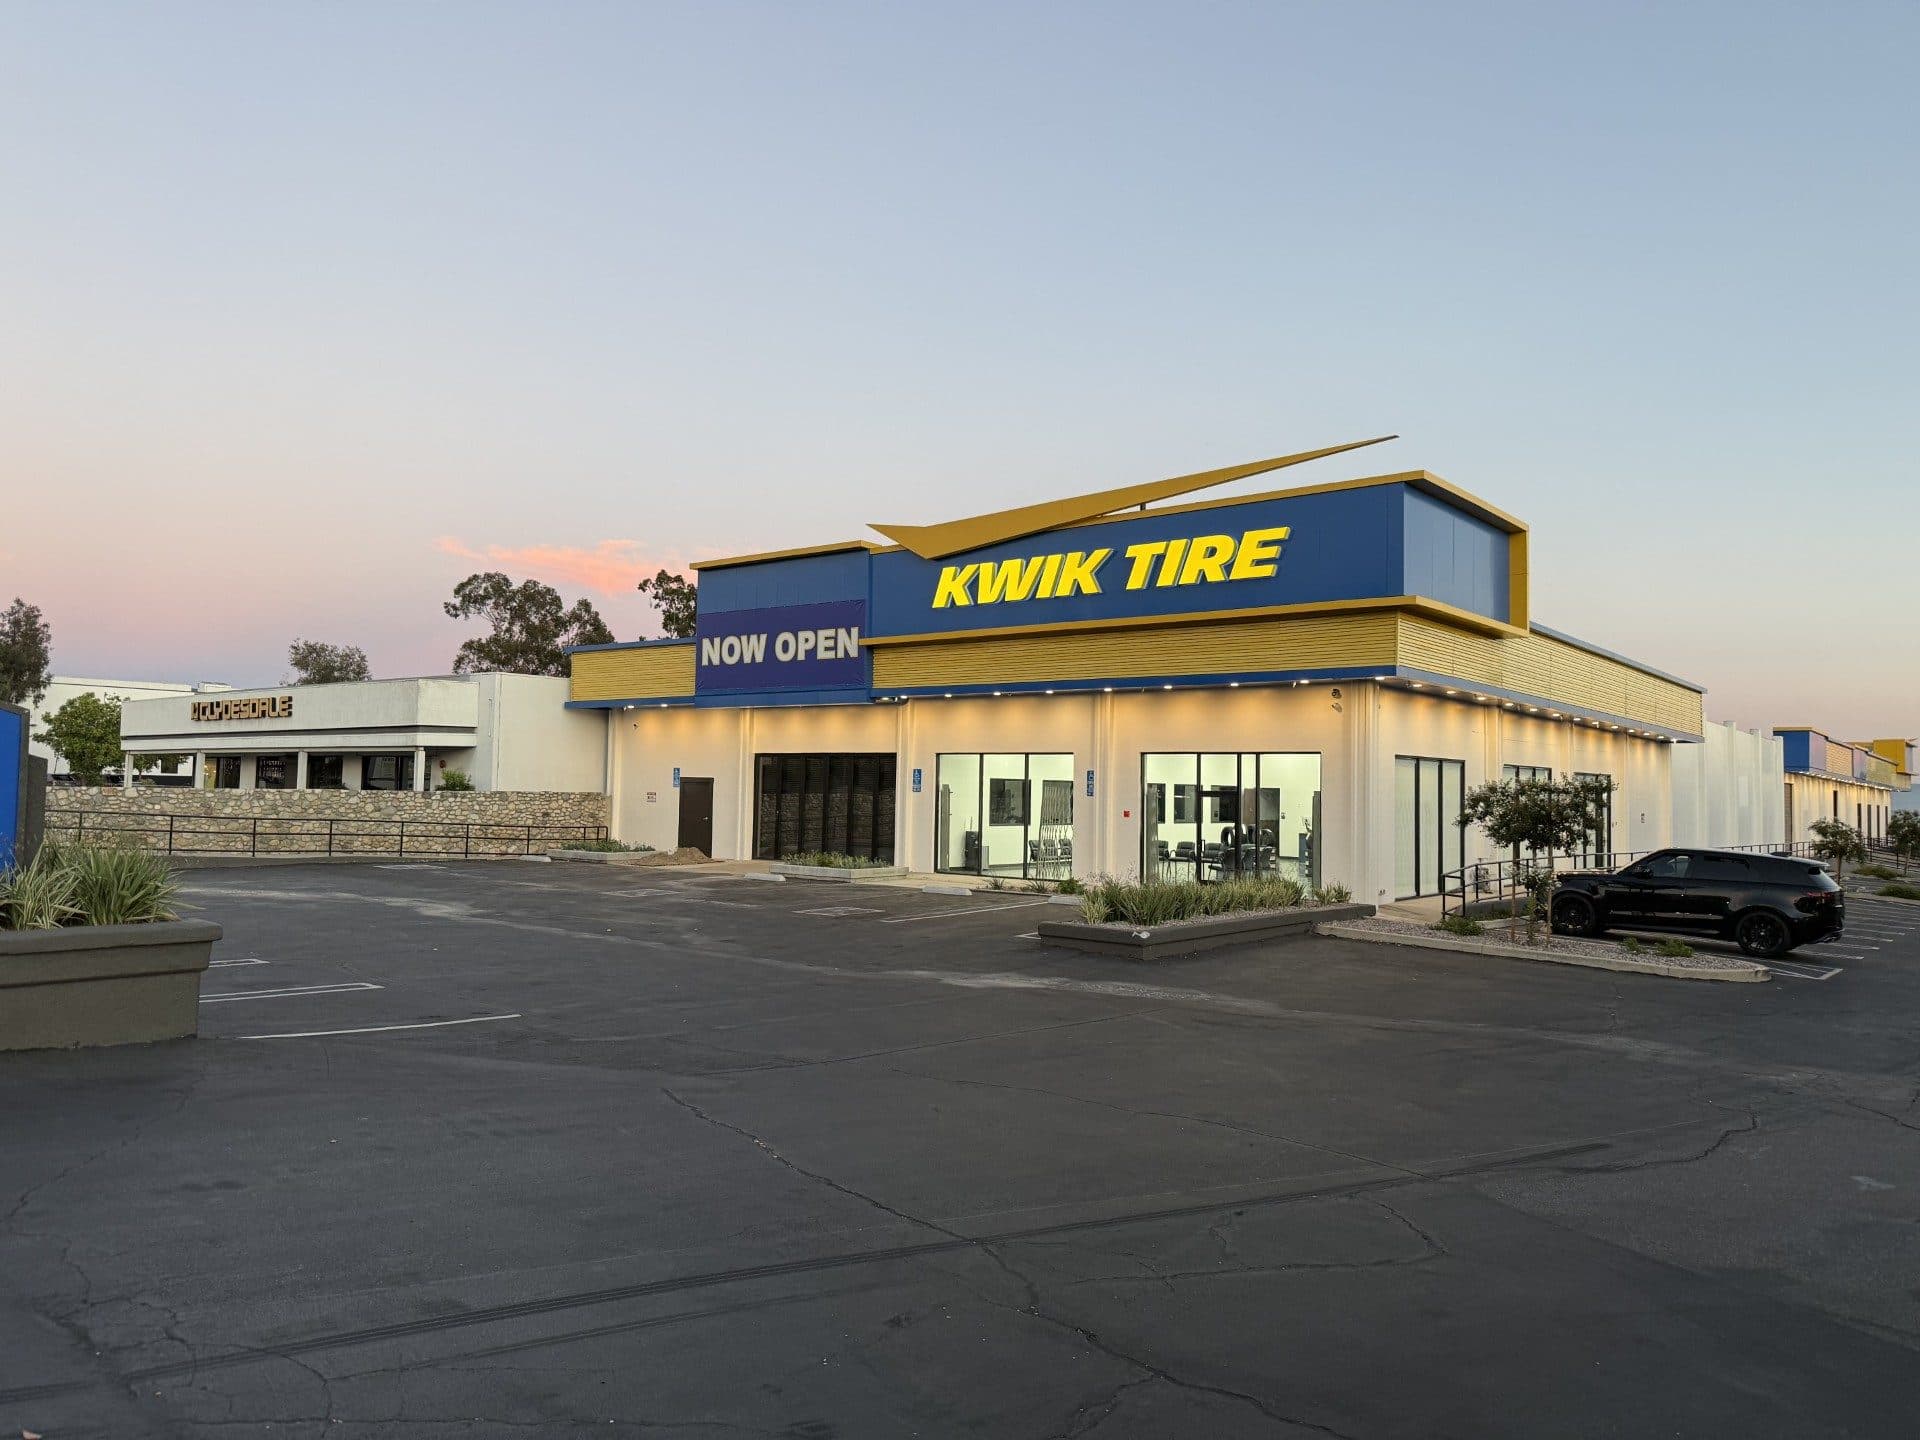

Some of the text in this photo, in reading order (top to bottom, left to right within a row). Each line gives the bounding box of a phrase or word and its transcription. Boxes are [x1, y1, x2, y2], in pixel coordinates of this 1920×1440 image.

[931, 526, 1291, 609] KWIK TIRE
[701, 626, 860, 666] NOW OPEN
[199, 696, 293, 720] CLYDESDALE
